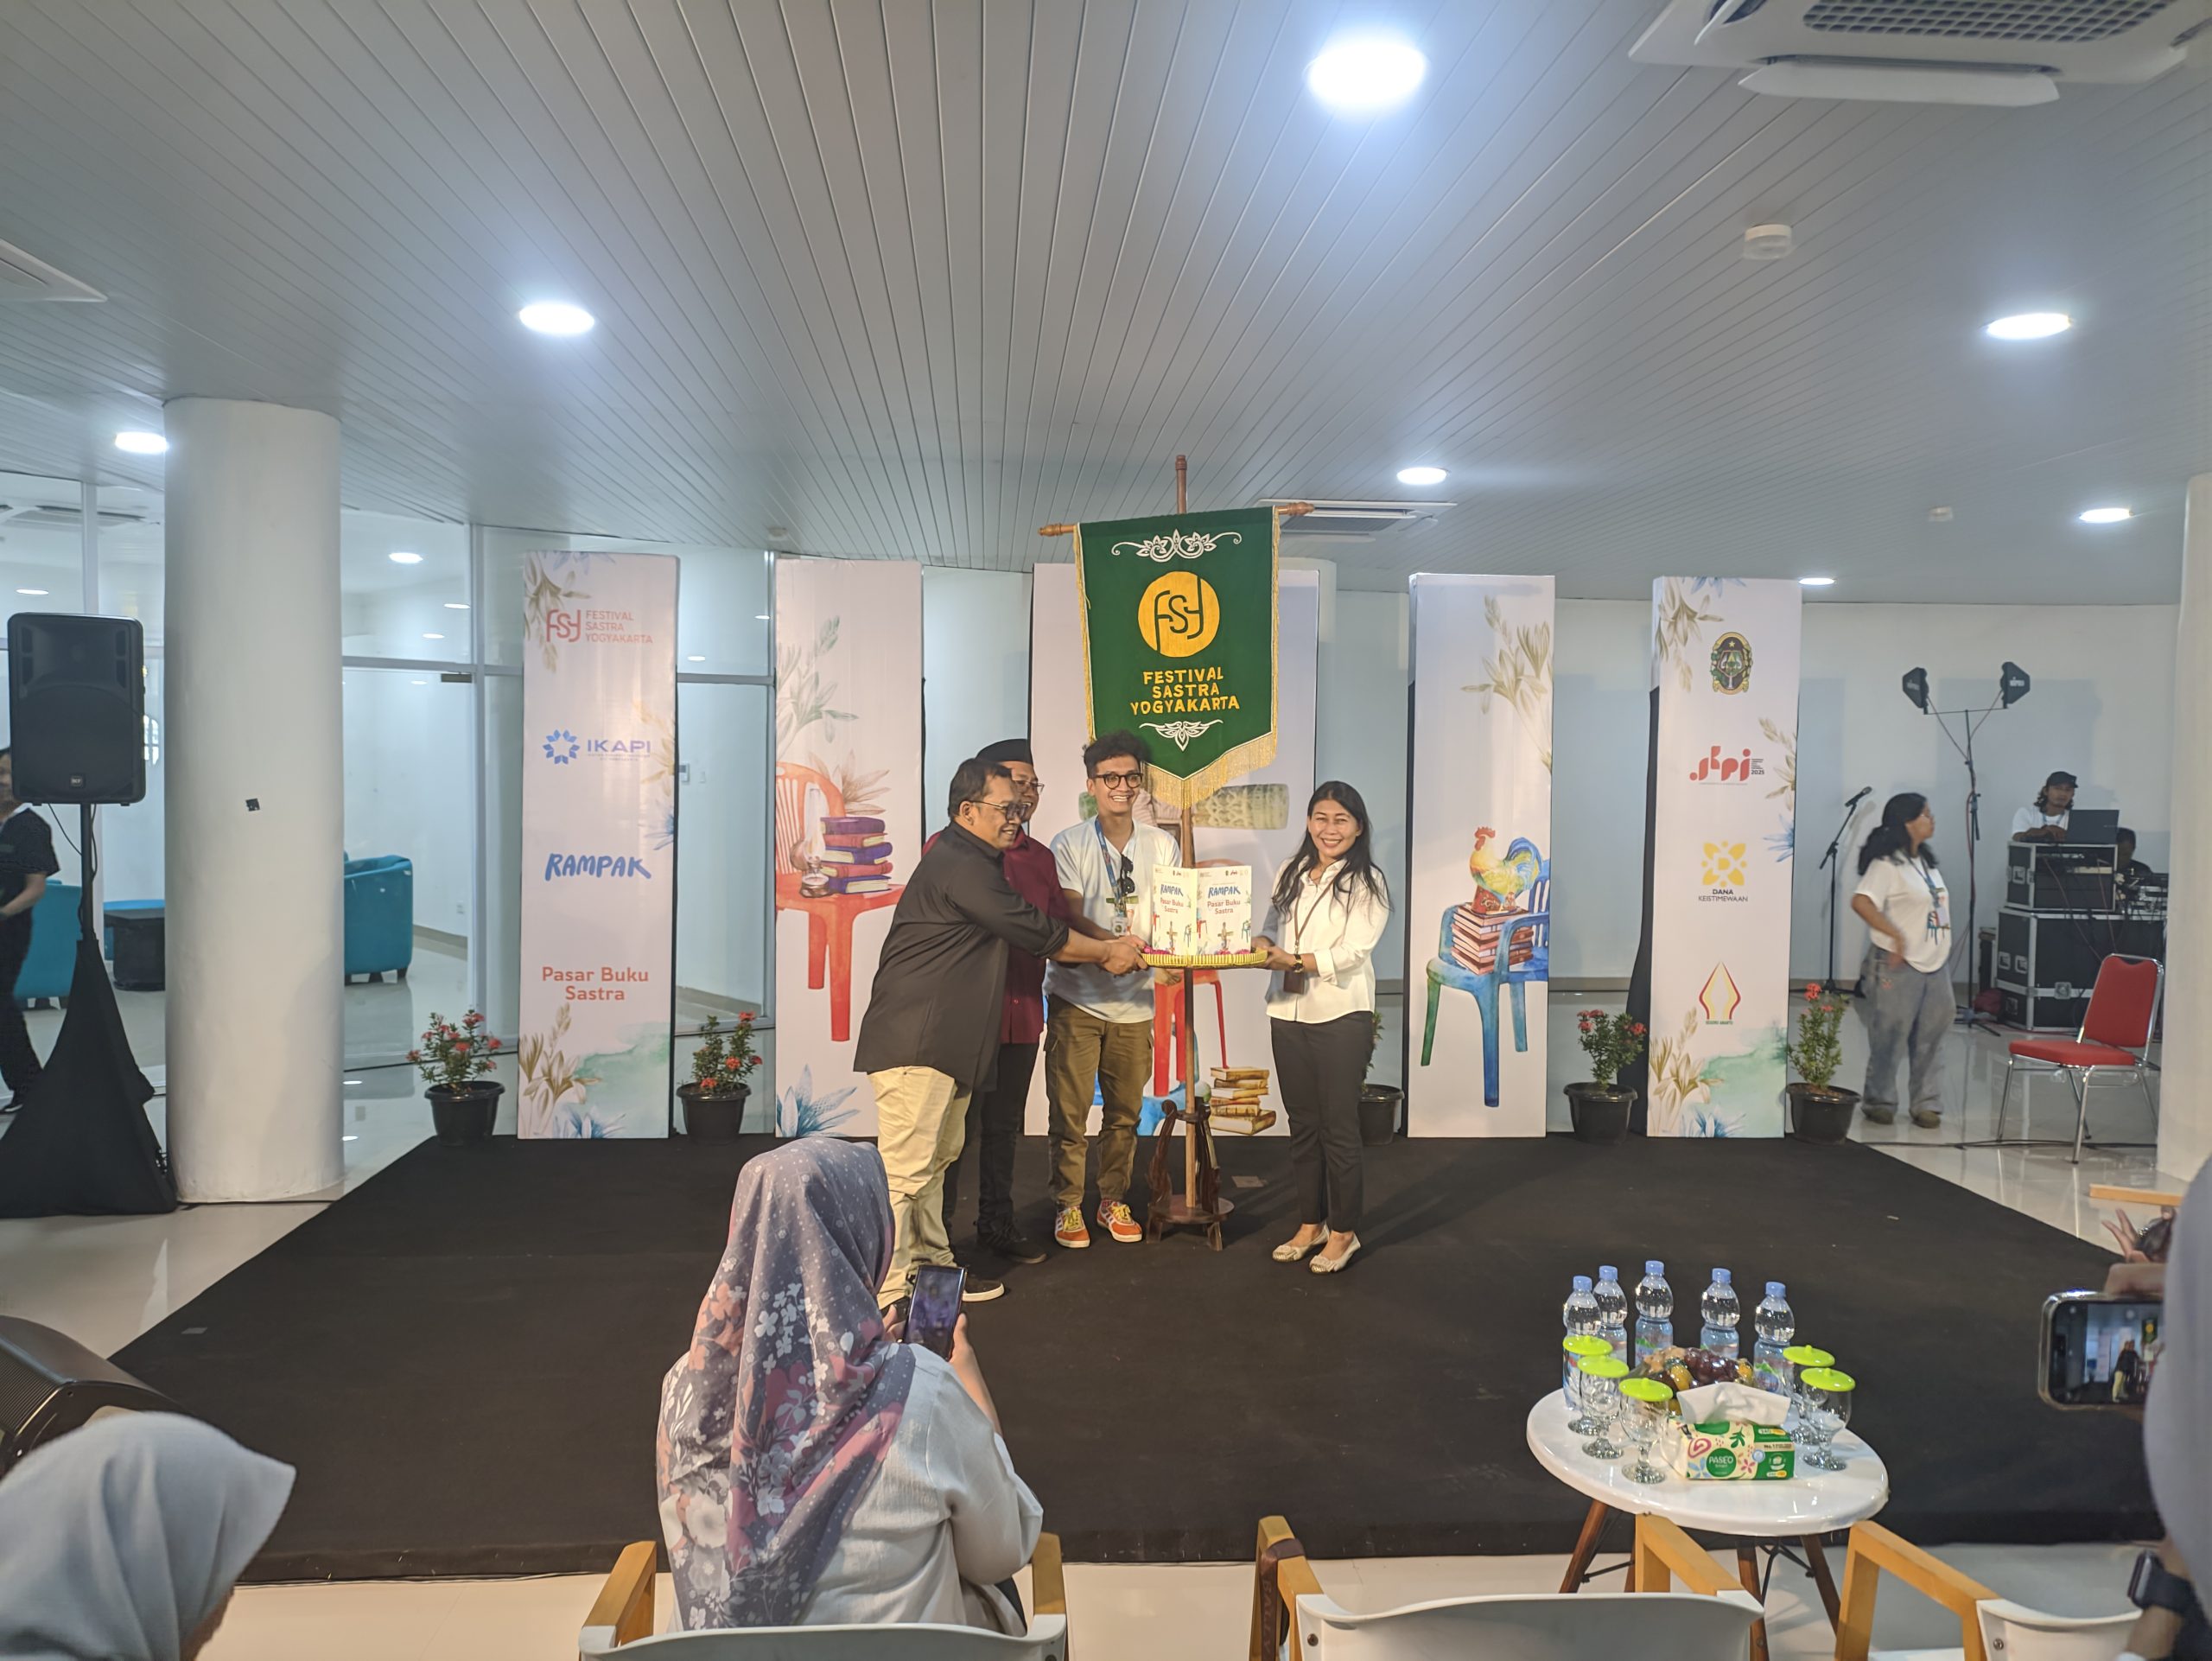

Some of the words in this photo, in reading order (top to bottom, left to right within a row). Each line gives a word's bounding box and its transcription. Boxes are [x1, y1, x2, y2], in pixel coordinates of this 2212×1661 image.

[585, 610, 634, 620] FESTIVAL
[585, 621, 625, 632] SASTRA
[585, 633, 653, 644] YOGYAKARTA
[1142, 666, 1224, 684] FESTIVAL
[1152, 682, 1220, 699] SASTRA
[1130, 695, 1240, 716] YOGYAKARTA
[588, 739, 651, 753] IKAPI
[544, 853, 652, 881] RAMPAK
[1160, 884, 1184, 897] RAMPAK
[1208, 886, 1241, 899] RAMPAK
[542, 966, 594, 982] Pasar
[601, 966, 649, 982] Buku
[565, 985, 625, 1000] Sastra
[1708, 1455, 1734, 1464] PASEO
